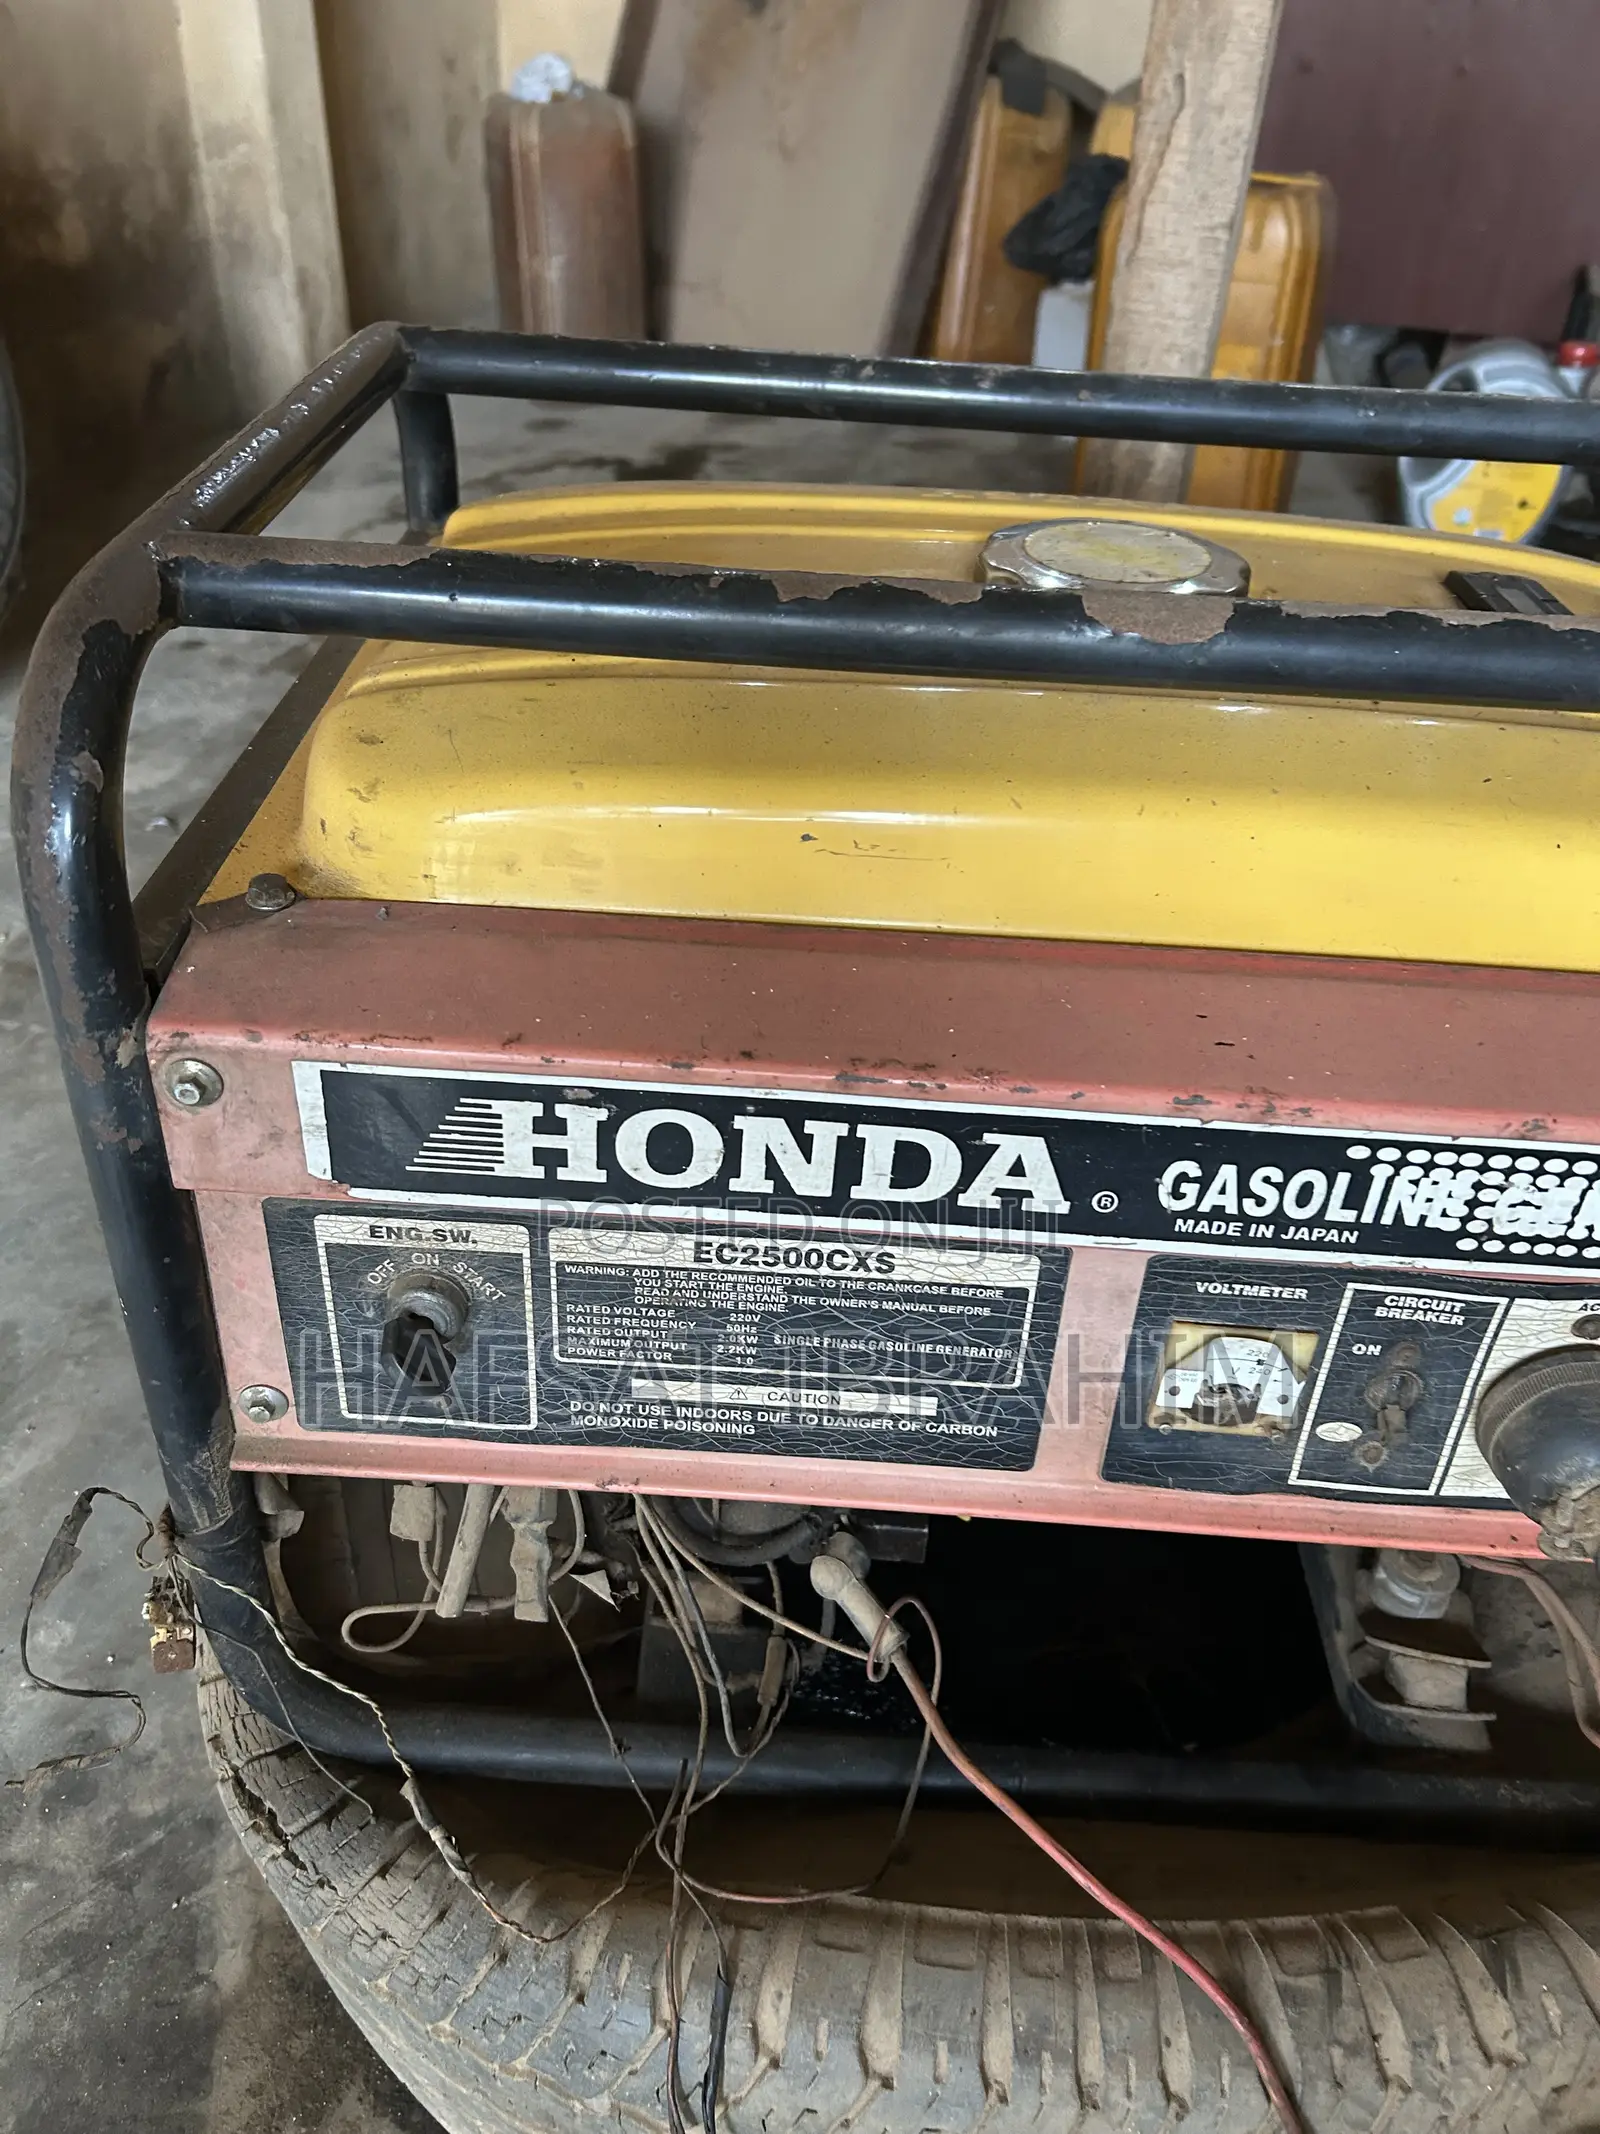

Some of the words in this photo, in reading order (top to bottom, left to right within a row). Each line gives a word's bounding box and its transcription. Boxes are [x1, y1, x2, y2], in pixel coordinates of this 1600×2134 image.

[490, 1098, 1071, 1213] HONDA
[1157, 1160, 1462, 1231] GASOLINE
[369, 1224, 478, 1244] ENG.SW.
[1174, 1218, 1244, 1236] MADE
[1248, 1223, 1275, 1238] IN
[1280, 1225, 1359, 1244] JAPAN
[694, 1241, 896, 1274] EC2500CXS
[366, 1259, 397, 1285] OFF
[411, 1252, 440, 1266] ON
[452, 1261, 507, 1301] START
[564, 1264, 630, 1277] WARNING:
[632, 1268, 660, 1279] ADD
[664, 1270, 688, 1280] THE
[691, 1271, 792, 1286] RECOMMENDED
[794, 1278, 816, 1287] OIL
[818, 1279, 836, 1288] TO
[840, 1280, 864, 1290] THE
[867, 1282, 948, 1295] CRANKCASE
[951, 1287, 1005, 1299] BEFORE
[634, 1277, 662, 1288] YOU
[664, 1279, 705, 1290] START
[708, 1281, 733, 1292] THE
[737, 1283, 788, 1295] ENGINE.
[1195, 1281, 1309, 1300] VOLTMETER
[634, 1287, 670, 1297] READ
[672, 1289, 700, 1299] AND
[703, 1290, 788, 1304] UNDERSTAND
[792, 1295, 817, 1306] THE
[819, 1297, 880, 1309] OWNER'S
[882, 1301, 936, 1313] MANUAL
[938, 1305, 992, 1316] BEFORE
[634, 1296, 707, 1309] OPERATING
[710, 1299, 735, 1310] THE
[737, 1301, 789, 1313] ENGINE.
[1384, 1295, 1466, 1313] CIRCUIT
[566, 1304, 611, 1316] RATED
[613, 1306, 676, 1318] VOLTAGE
[729, 1312, 761, 1323] 220V
[1374, 1306, 1466, 1326] BREAKER
[566, 1315, 611, 1325] RATED
[614, 1317, 697, 1330] FREQUENCY
[726, 1323, 758, 1334] 50Hz
[566, 1325, 611, 1336] RATED
[614, 1327, 669, 1339] OUTPUT
[773, 1335, 821, 1347] SINGLE
[823, 1337, 866, 1350] PHASE
[868, 1340, 934, 1354] GASOLINE
[936, 1344, 1012, 1359] GENERATOR
[567, 1336, 631, 1348] MAXIMUM
[633, 1339, 688, 1351] OUTPUT
[717, 1344, 758, 1356] 2.2KW
[1351, 1343, 1382, 1356] ON
[567, 1347, 616, 1358] POWER
[619, 1350, 673, 1362] FACTOR
[1246, 1349, 1271, 1358] 220
[767, 1391, 842, 1406] CAUTION
[570, 1401, 595, 1413] DO
[599, 1402, 635, 1415] NOT
[638, 1404, 672, 1417] USE
[676, 1406, 753, 1421] INDOORS
[757, 1411, 792, 1424] DUE
[798, 1413, 819, 1425] TO
[822, 1415, 894, 1430] DANGER
[898, 1420, 922, 1431] OF
[925, 1422, 998, 1437] CARBON
[570, 1414, 659, 1430] MONOXIDE
[663, 1418, 756, 1435] POISONING
